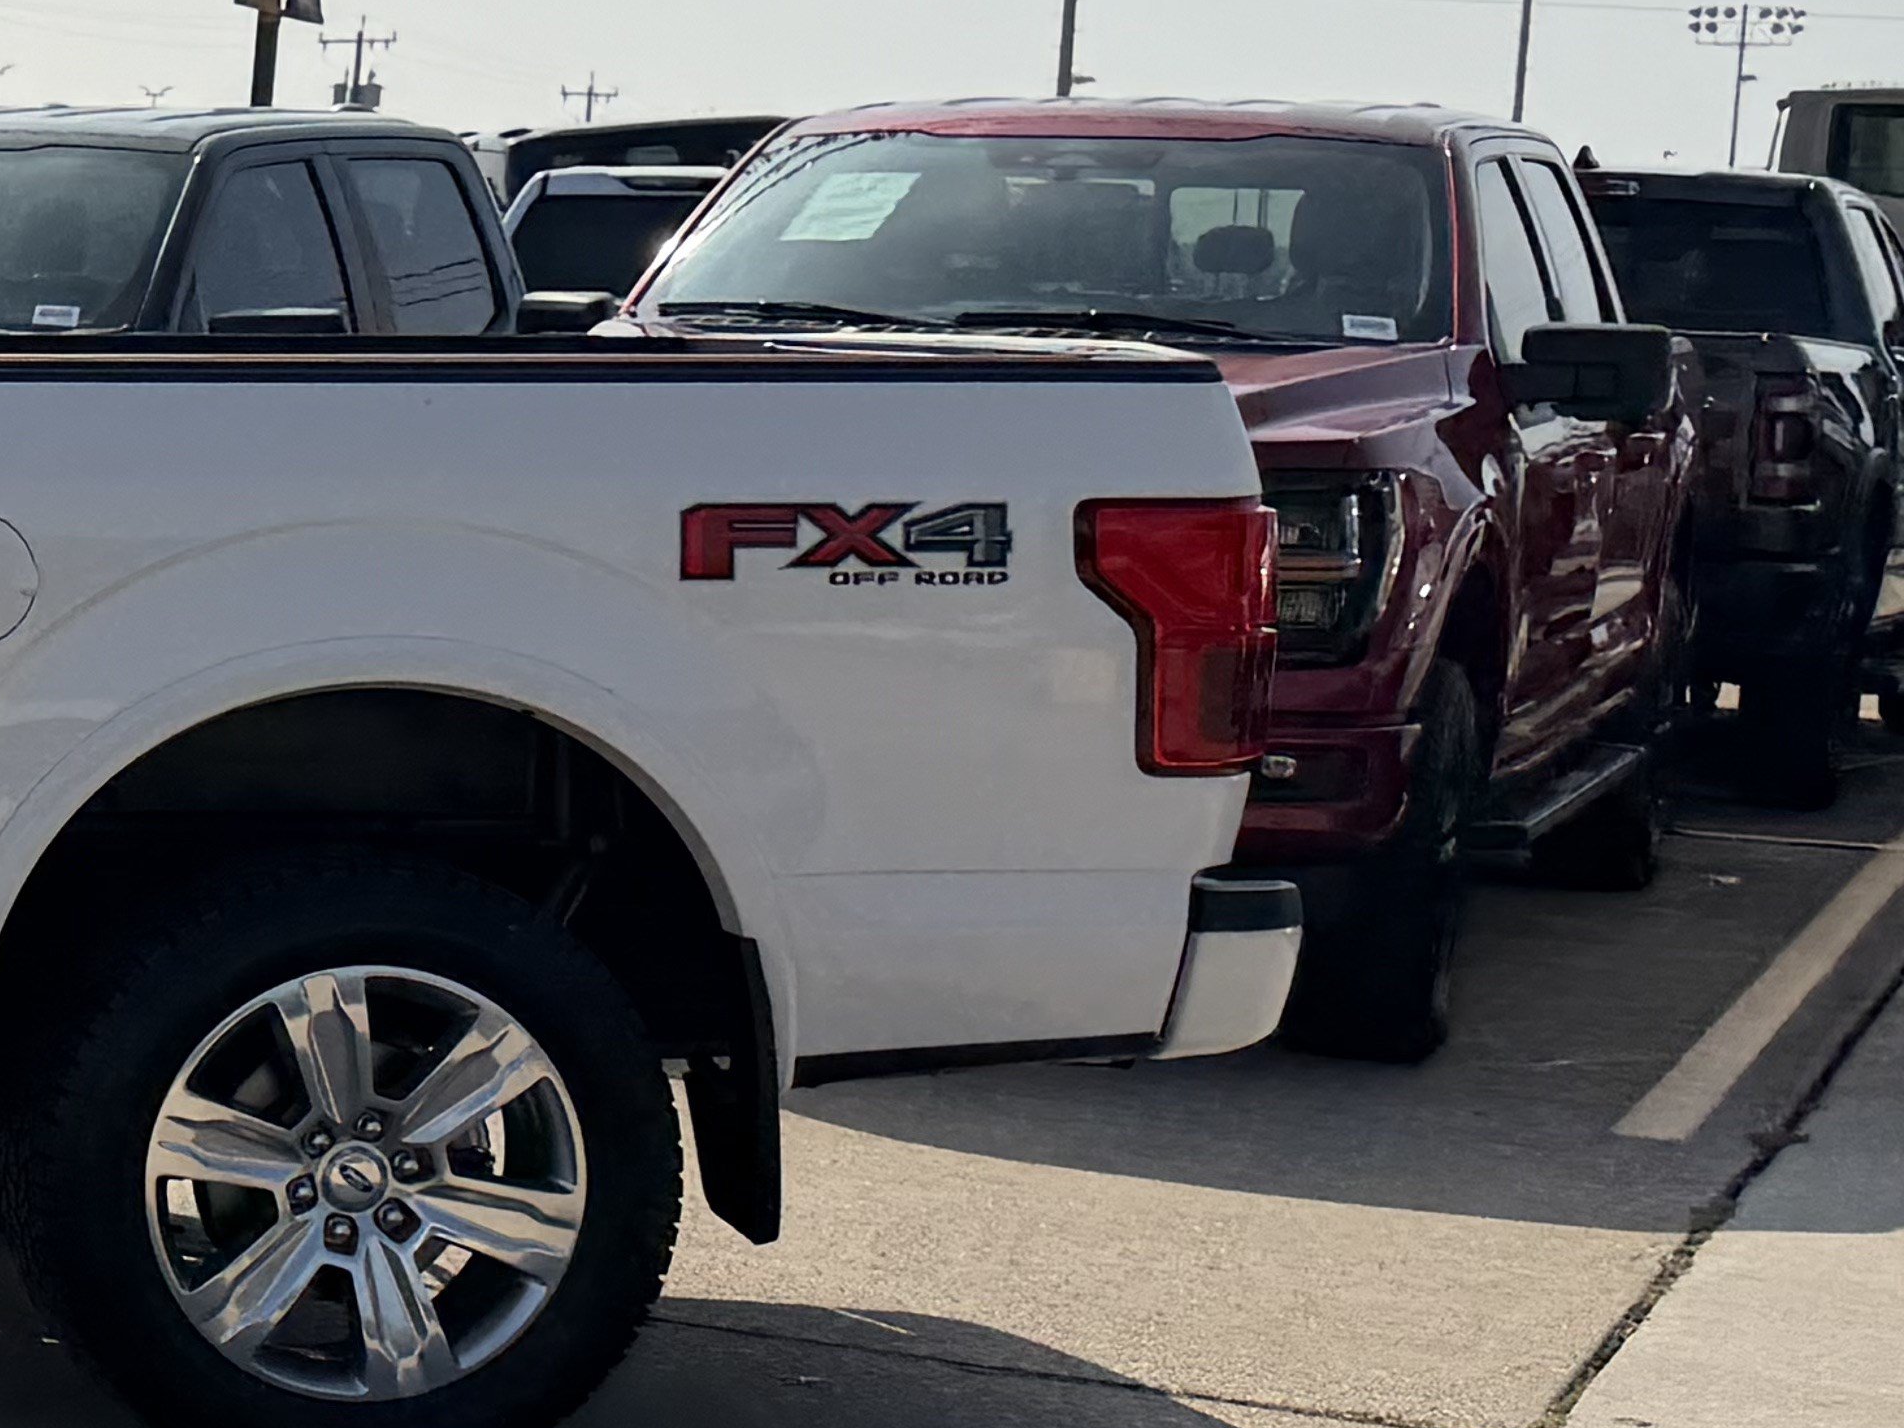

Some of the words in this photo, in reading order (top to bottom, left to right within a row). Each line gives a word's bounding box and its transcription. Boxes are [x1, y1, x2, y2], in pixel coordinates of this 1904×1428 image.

[679, 500, 1013, 581] FX4
[829, 571, 899, 586] OFF
[915, 571, 1009, 587] ROAD
